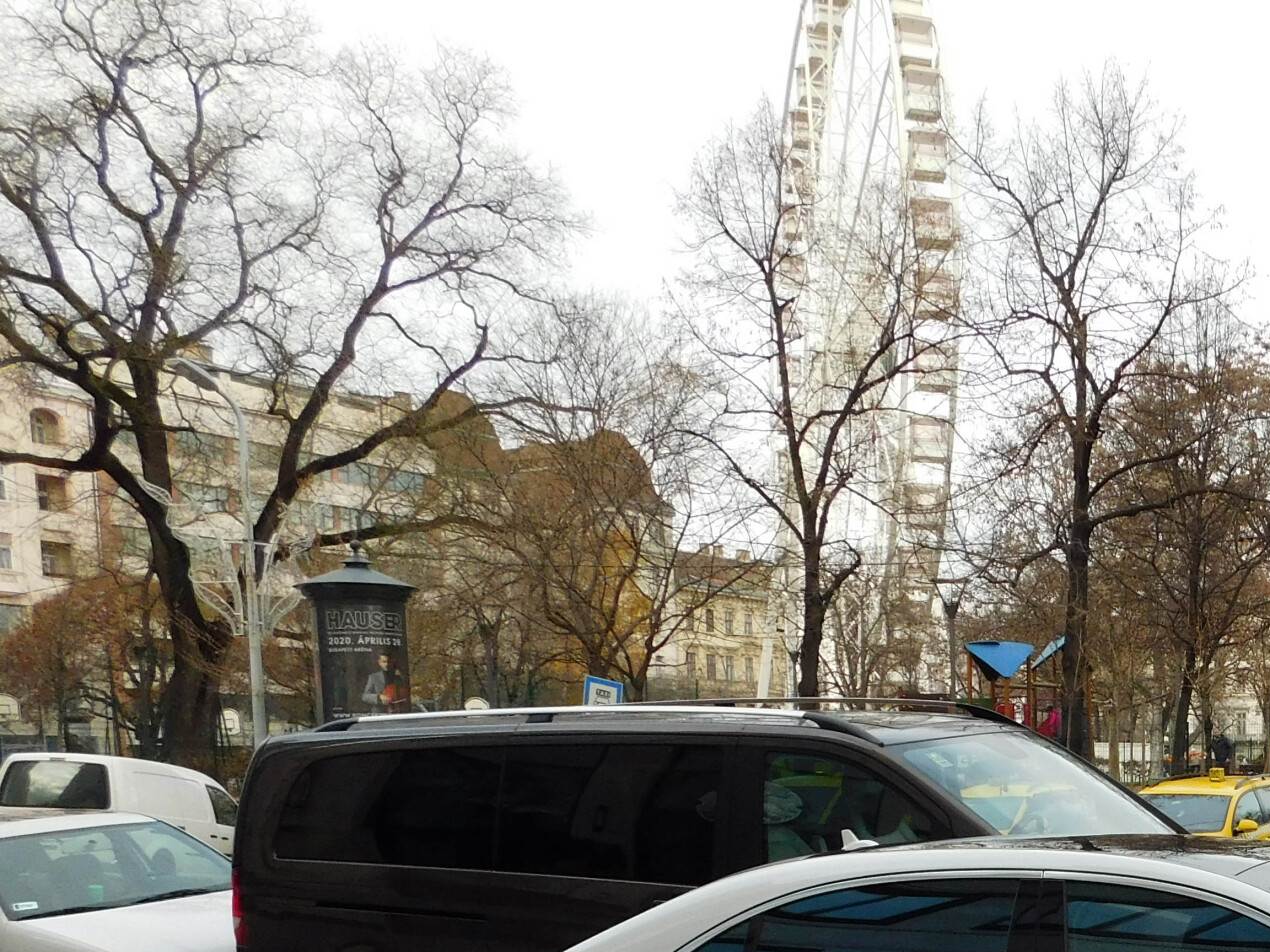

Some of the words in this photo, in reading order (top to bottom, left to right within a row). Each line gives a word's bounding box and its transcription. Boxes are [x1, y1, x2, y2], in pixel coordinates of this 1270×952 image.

[326, 610, 402, 631] HAUSER
[328, 636, 354, 645] 2020.
[358, 634, 391, 646] ÁPRILIS
